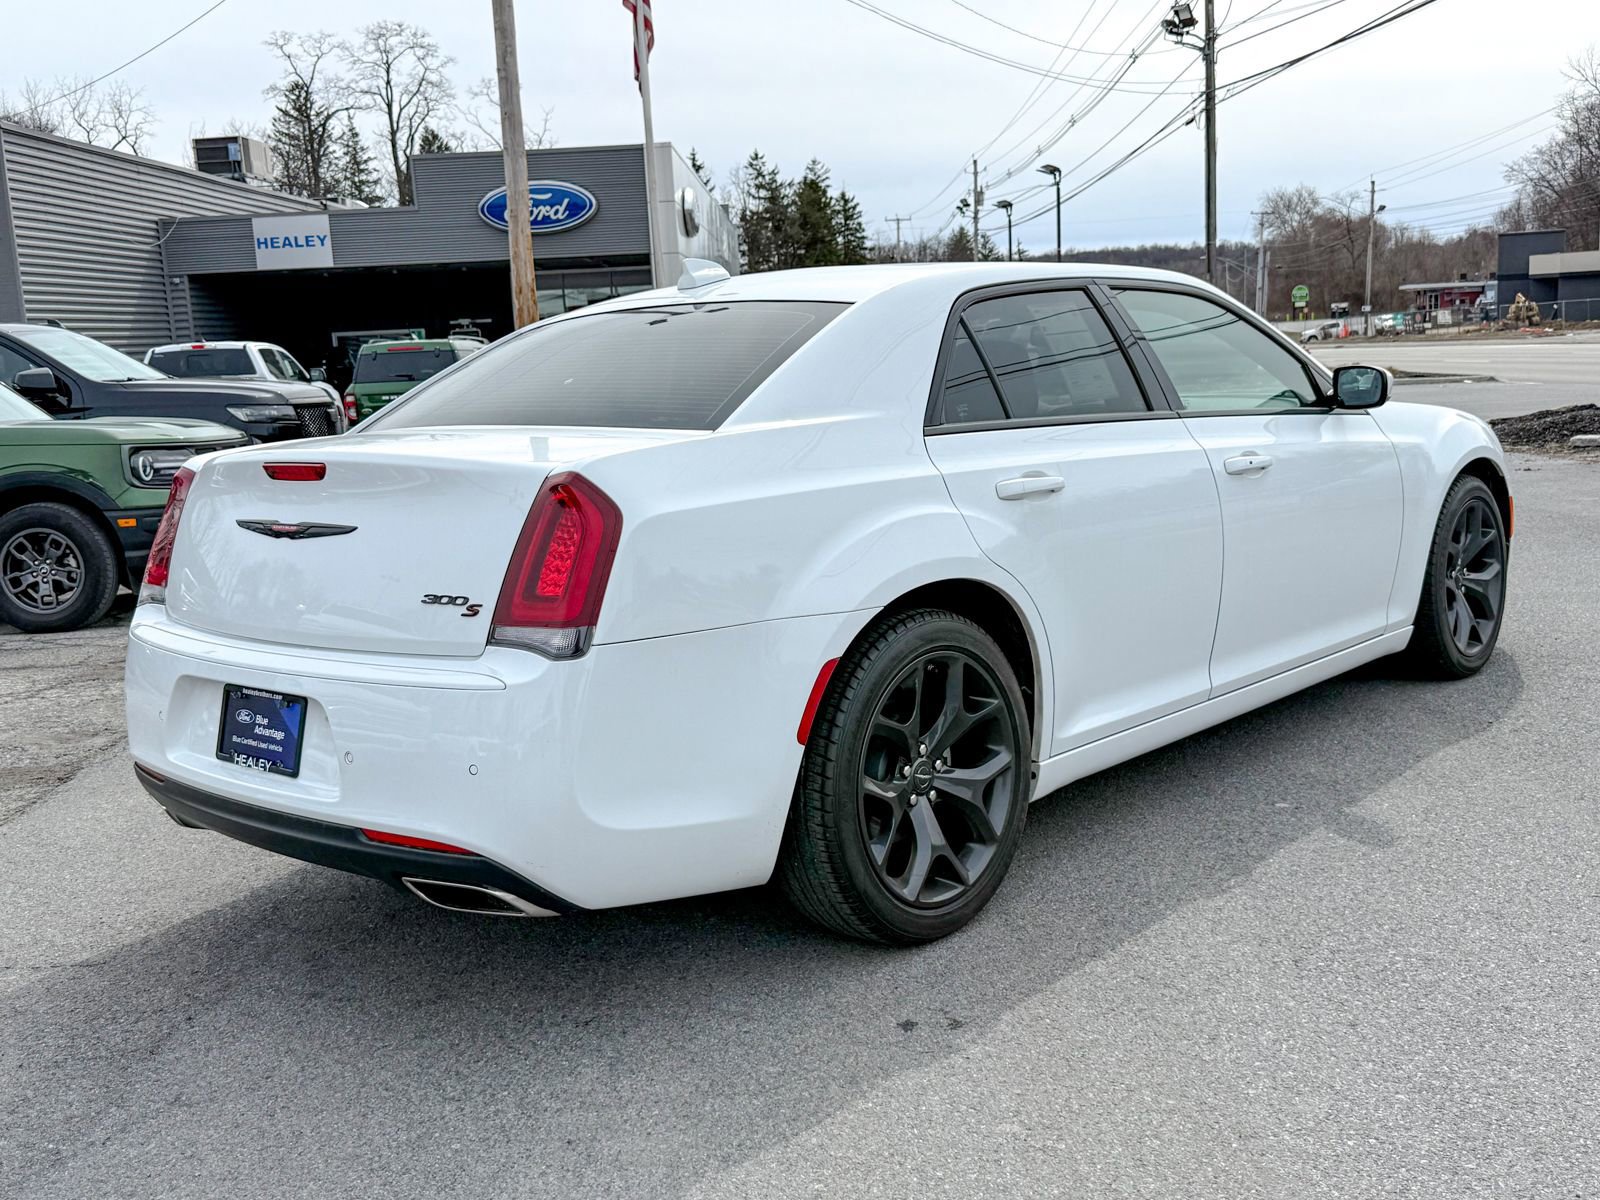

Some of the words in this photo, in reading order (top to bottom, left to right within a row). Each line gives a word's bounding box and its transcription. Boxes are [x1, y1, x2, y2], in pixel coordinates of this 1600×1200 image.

[256, 235, 328, 250] HEALEY
[255, 714, 269, 726] Blue
[254, 725, 285, 740] Advantage
[232, 735, 242, 743] Blue
[241, 737, 258, 747] Certified
[258, 740, 268, 749] Used
[268, 743, 283, 752] Vehicle
[234, 752, 273, 772] HEALEY
